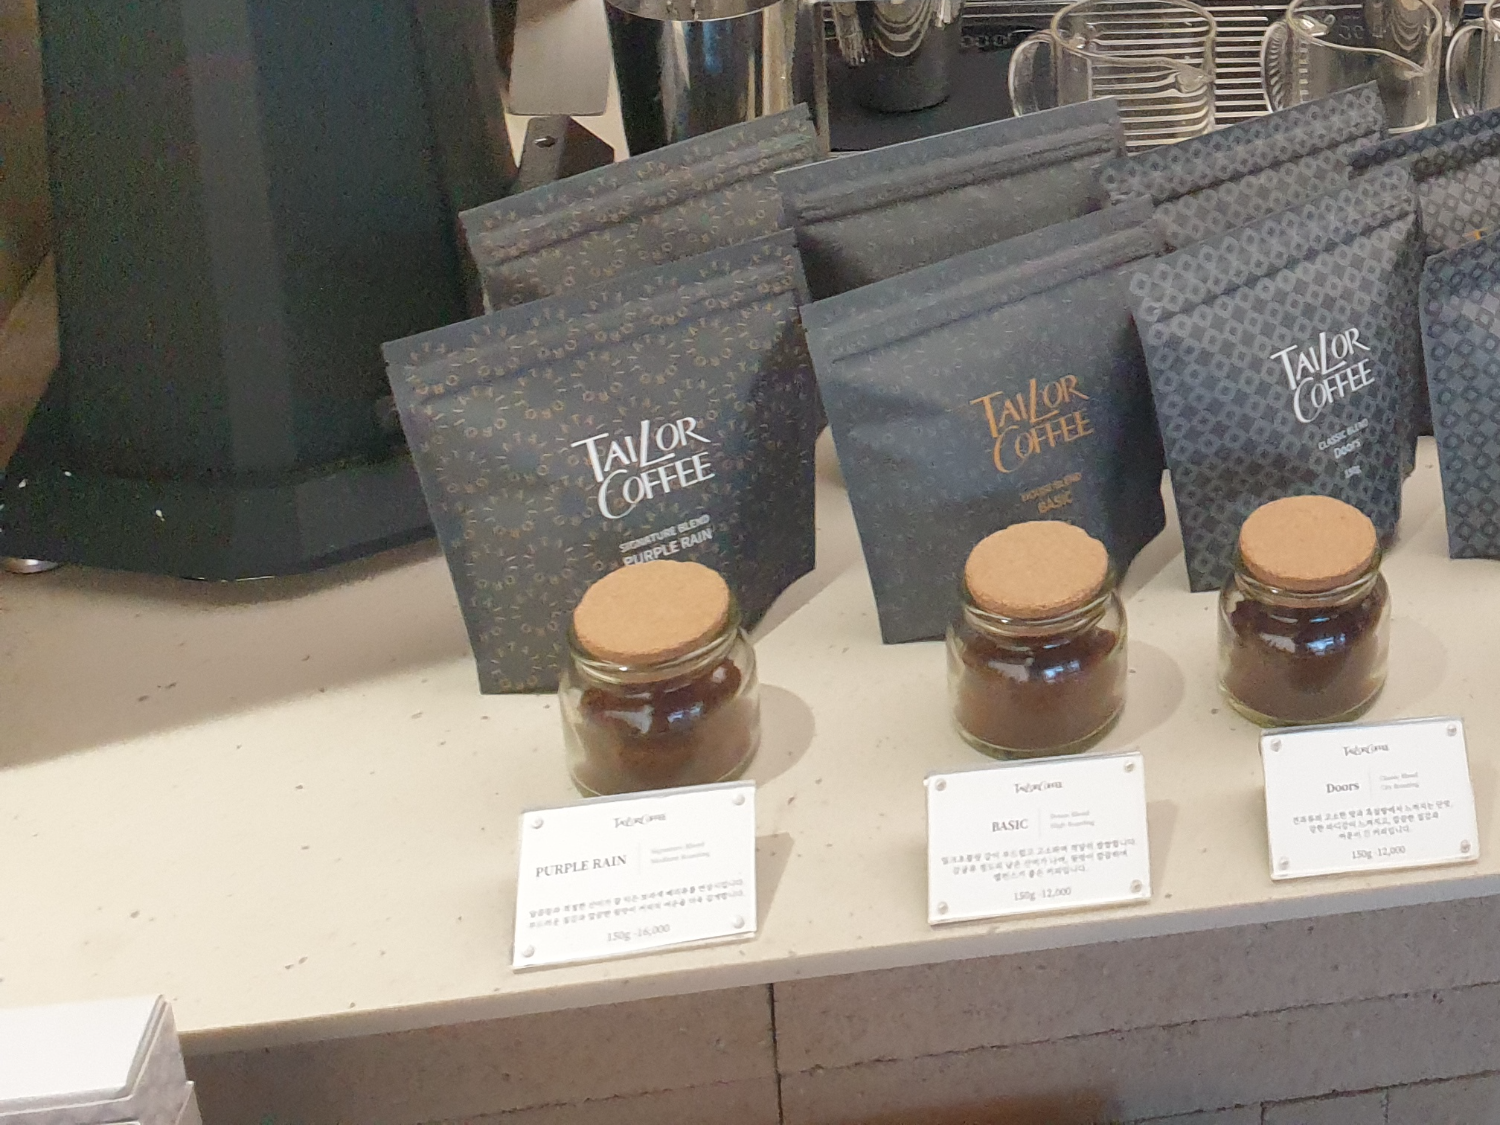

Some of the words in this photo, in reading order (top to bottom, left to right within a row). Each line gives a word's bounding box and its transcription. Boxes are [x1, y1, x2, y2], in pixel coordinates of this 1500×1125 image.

[1270, 327, 1370, 390] TAILOR
[970, 375, 1090, 438] TAILOR
[1294, 359, 1375, 423] COFFEE
[571, 417, 711, 482] TAILOR
[994, 409, 1094, 473] COFFEE
[598, 451, 715, 519] COFFEE
[1038, 491, 1072, 513] BASIC
[619, 525, 677, 553] SIGNATURE
[678, 514, 710, 533] BLEND
[623, 539, 680, 565] PURPLE
[681, 528, 713, 549] RAIN
[1326, 783, 1360, 793] Doors
[992, 819, 1029, 832] BASIC
[536, 860, 588, 877] PURPLE
[592, 855, 628, 869] RAIN
[1352, 849, 1372, 859] 150g
[1378, 846, 1406, 857] 12,000
[1014, 890, 1036, 901] 150g
[1042, 887, 1072, 898] 12,000
[608, 927, 630, 942] 150g
